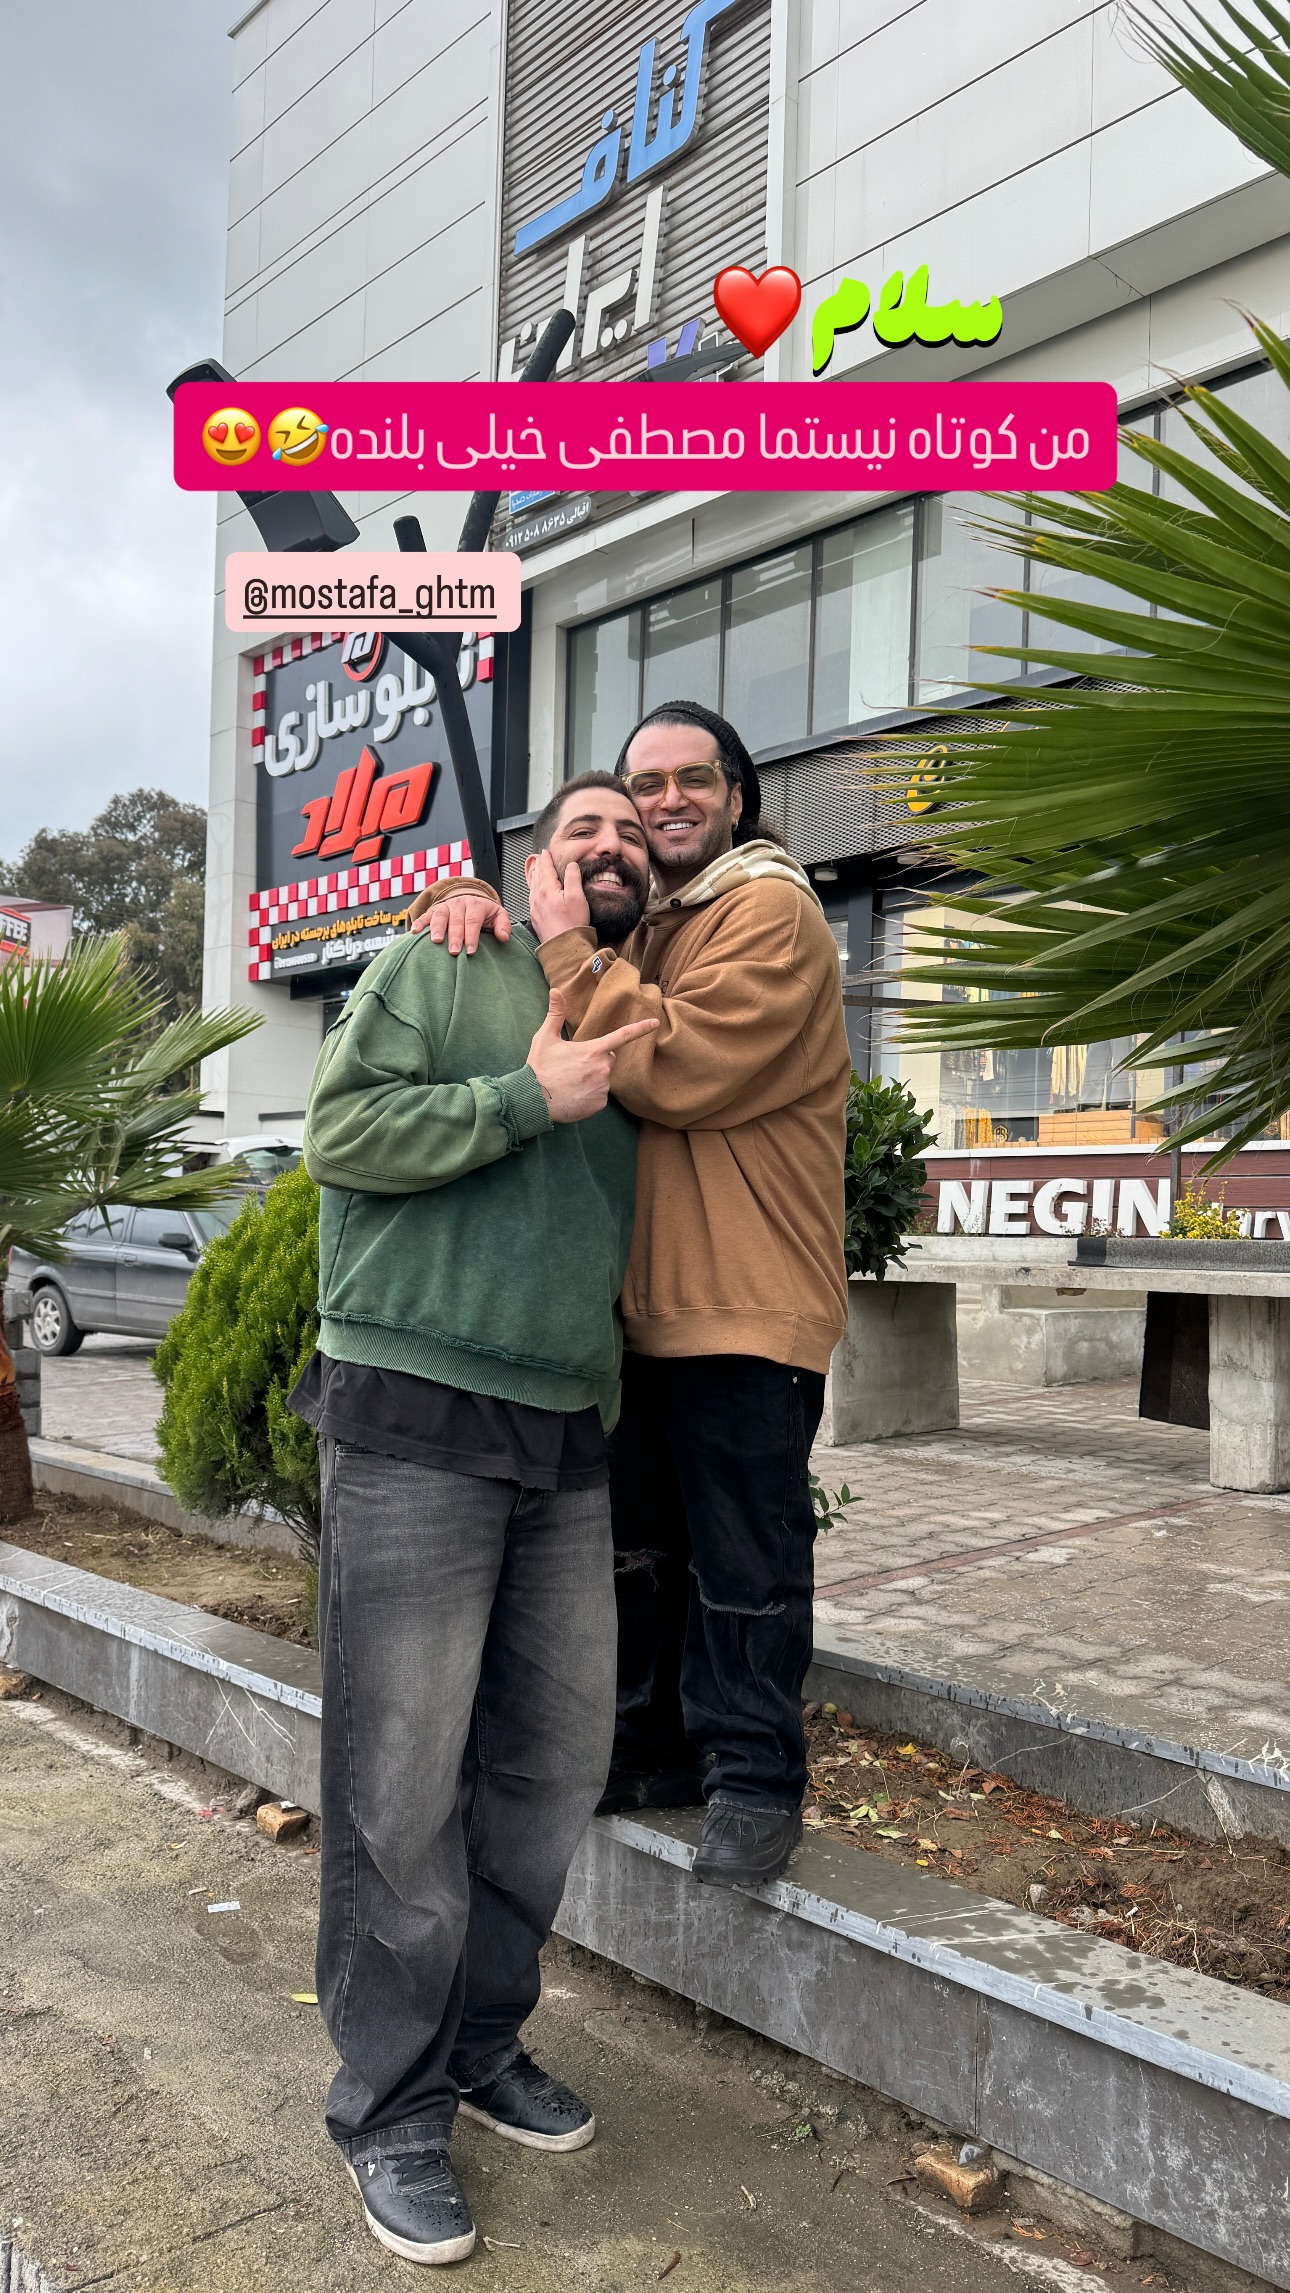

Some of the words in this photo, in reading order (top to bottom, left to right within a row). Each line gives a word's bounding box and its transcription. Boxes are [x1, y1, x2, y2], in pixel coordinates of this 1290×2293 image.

[291, 744, 436, 865] میلاد
[300, 925, 330, 942] برجسته
[364, 910, 392, 927] ساخت
[937, 1178, 1172, 1239] NEGIN
